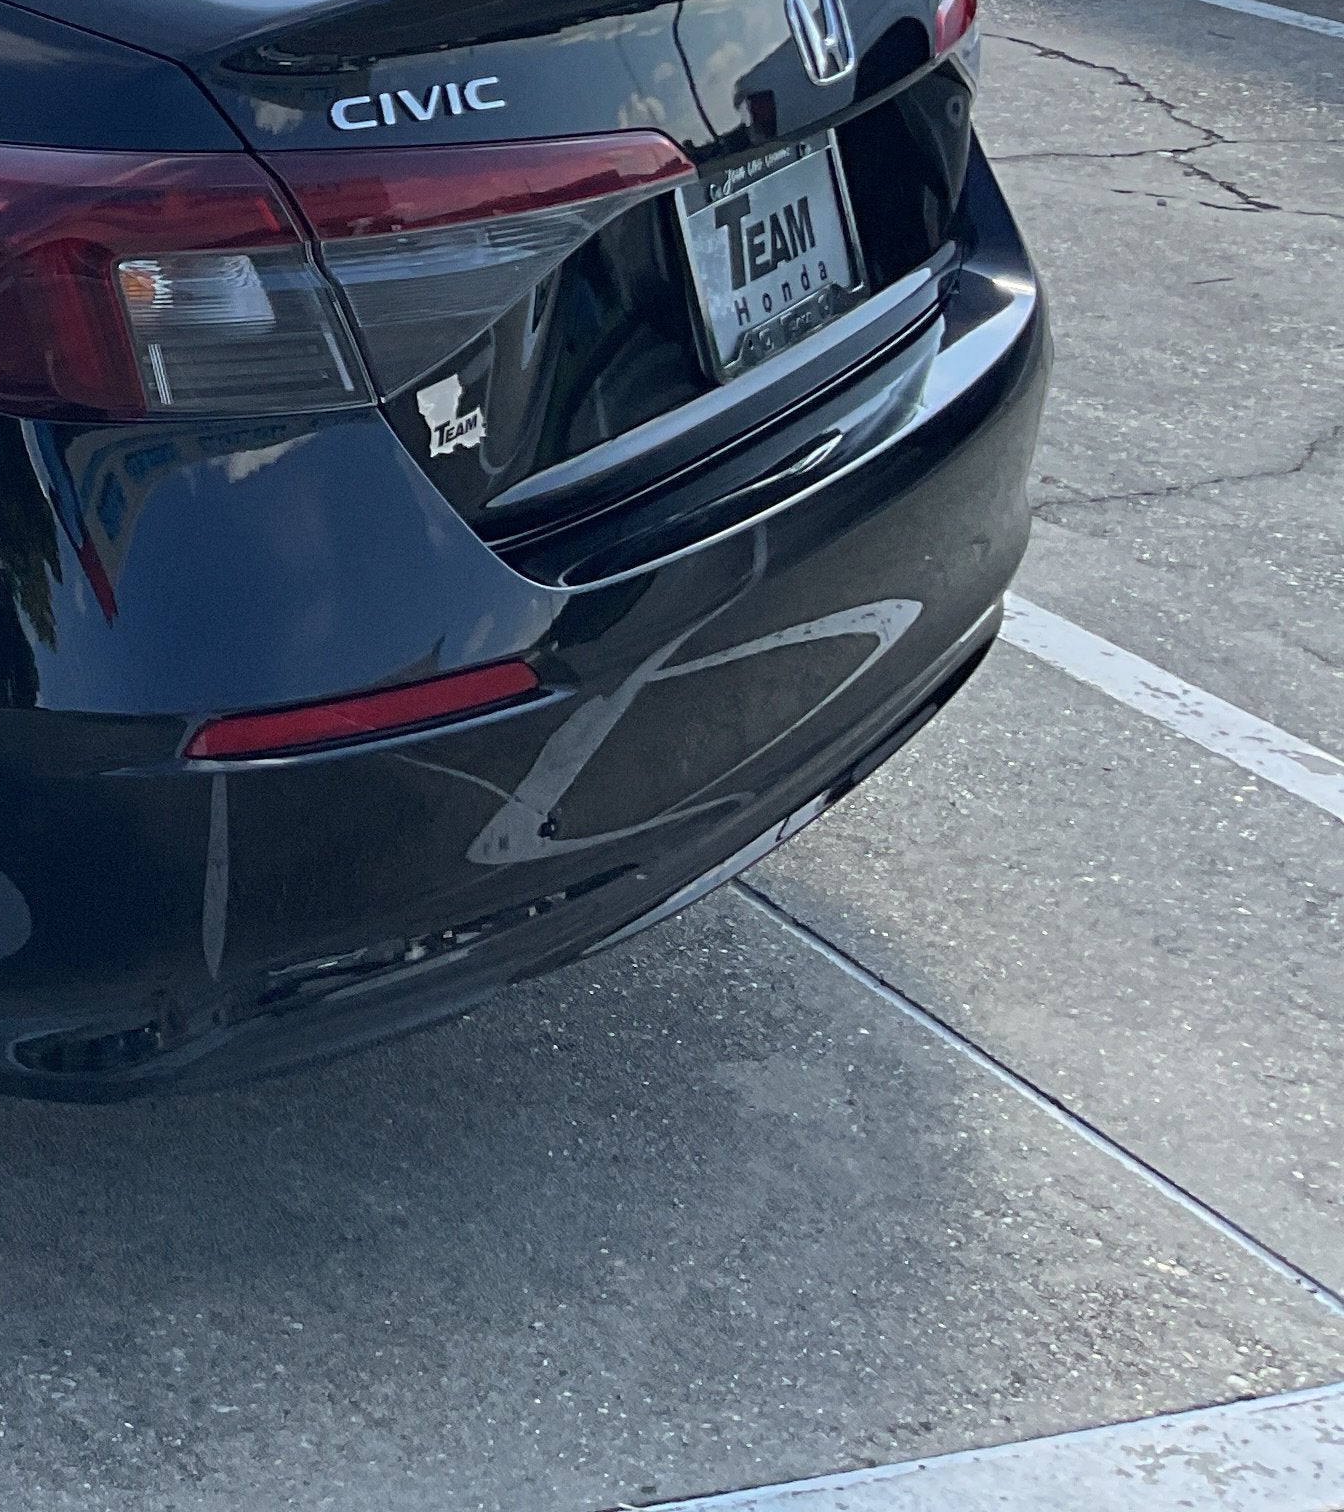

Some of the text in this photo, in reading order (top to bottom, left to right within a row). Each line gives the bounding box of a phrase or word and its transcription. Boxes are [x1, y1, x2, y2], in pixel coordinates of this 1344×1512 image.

[330, 76, 506, 130] CIVIC
[714, 192, 816, 292] TEAM
[734, 260, 828, 326] Honda
[434, 414, 478, 448] TEAM
